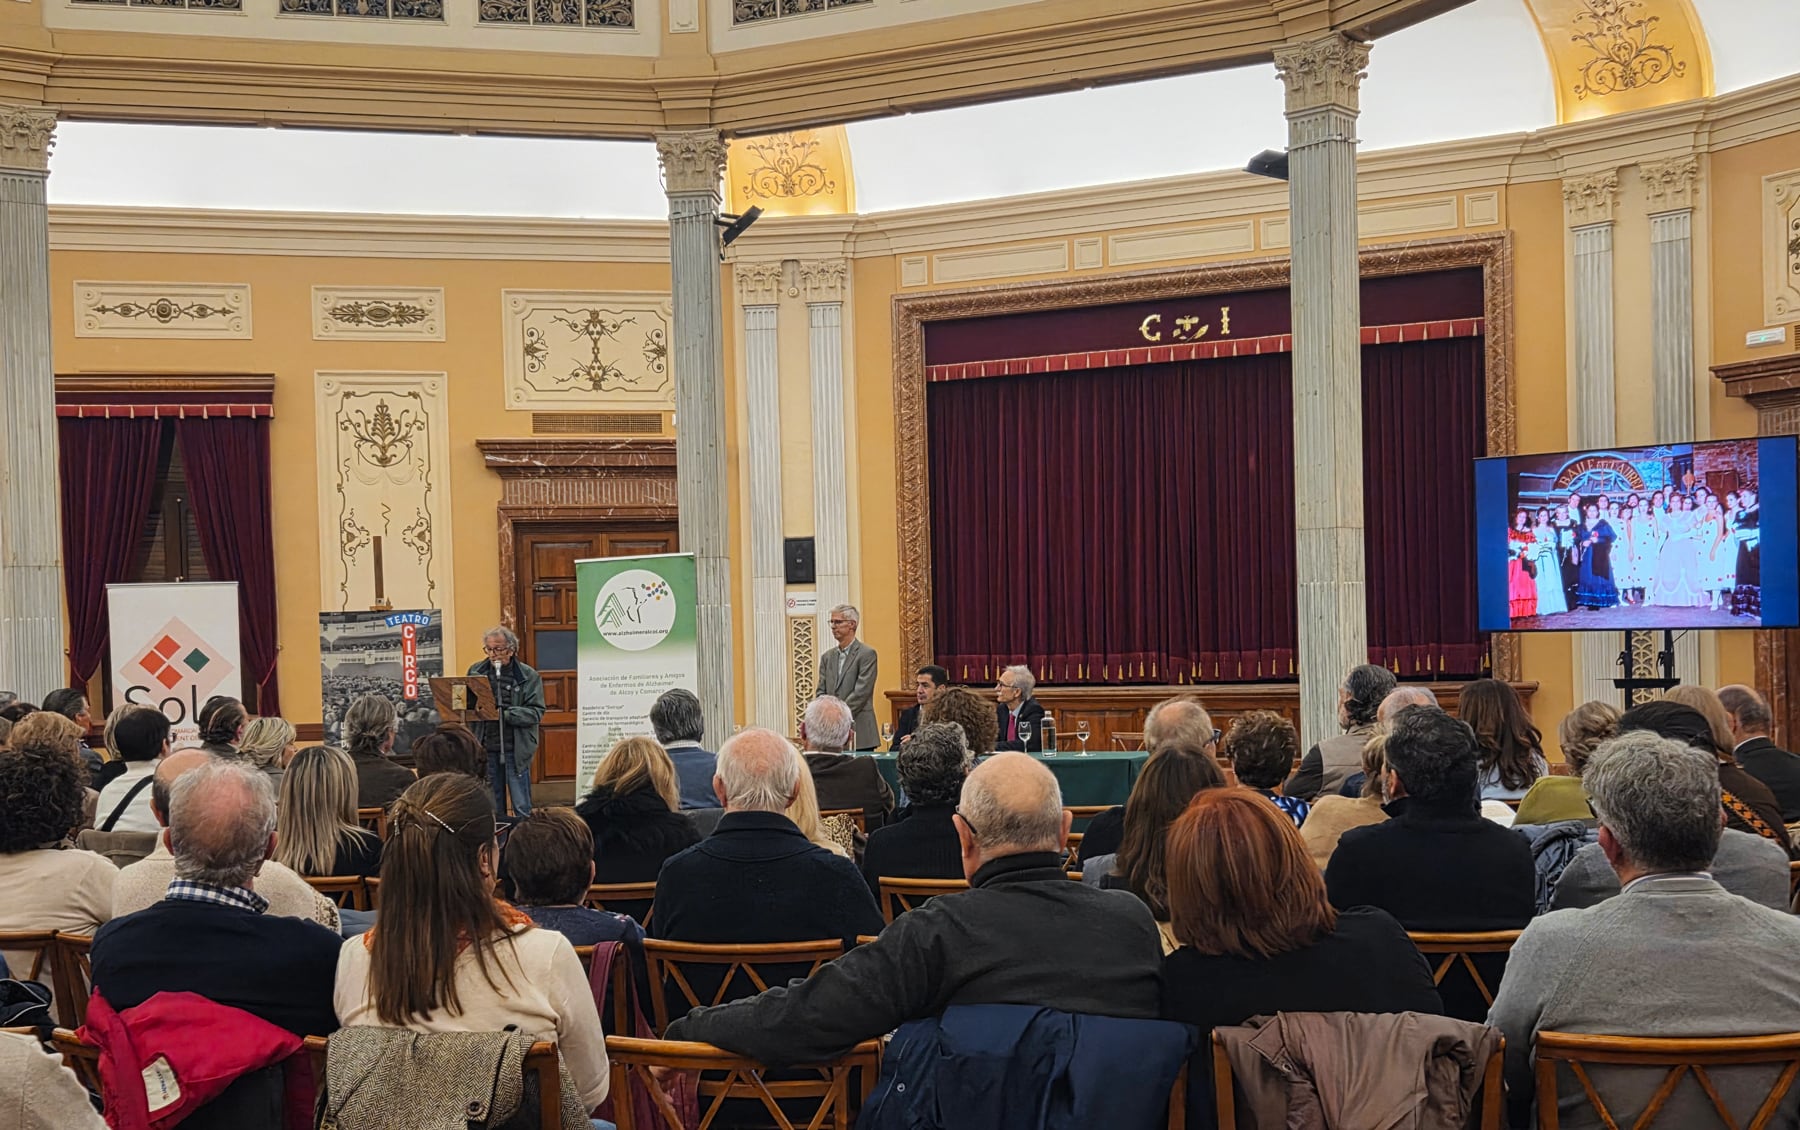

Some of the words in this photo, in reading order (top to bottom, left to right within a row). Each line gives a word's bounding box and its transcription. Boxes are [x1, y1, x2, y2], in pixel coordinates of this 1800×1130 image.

[387, 614, 430, 626] TEATRO
[403, 625, 416, 697] CIRCO
[629, 673, 658, 681] Familiares
[664, 672, 686, 680] Amigos
